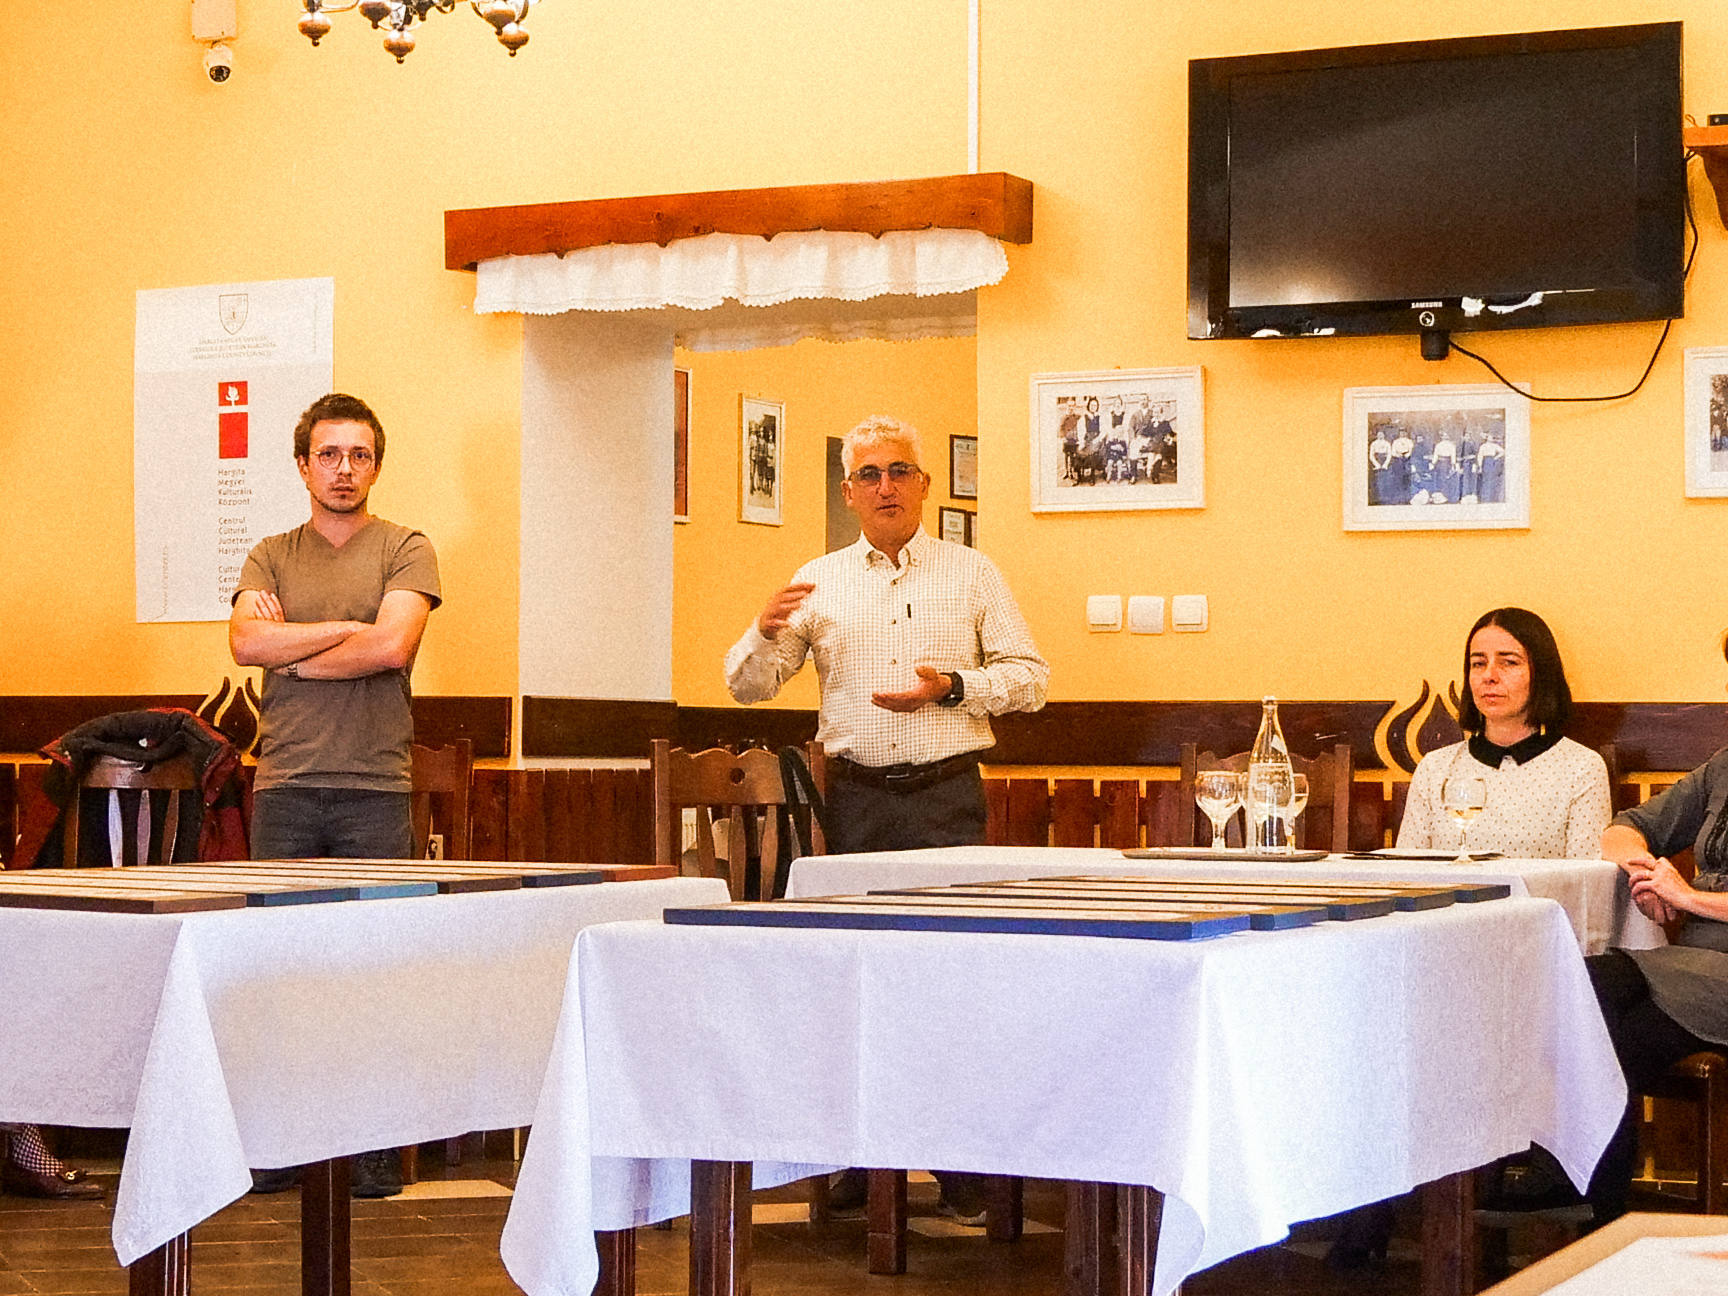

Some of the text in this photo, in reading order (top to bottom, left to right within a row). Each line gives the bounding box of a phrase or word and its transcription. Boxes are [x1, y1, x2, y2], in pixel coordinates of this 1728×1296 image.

[218, 517, 246, 525] Centrul
[218, 526, 248, 535] Cultural
[218, 565, 240, 574] Cultur
[218, 575, 240, 584] Cente
